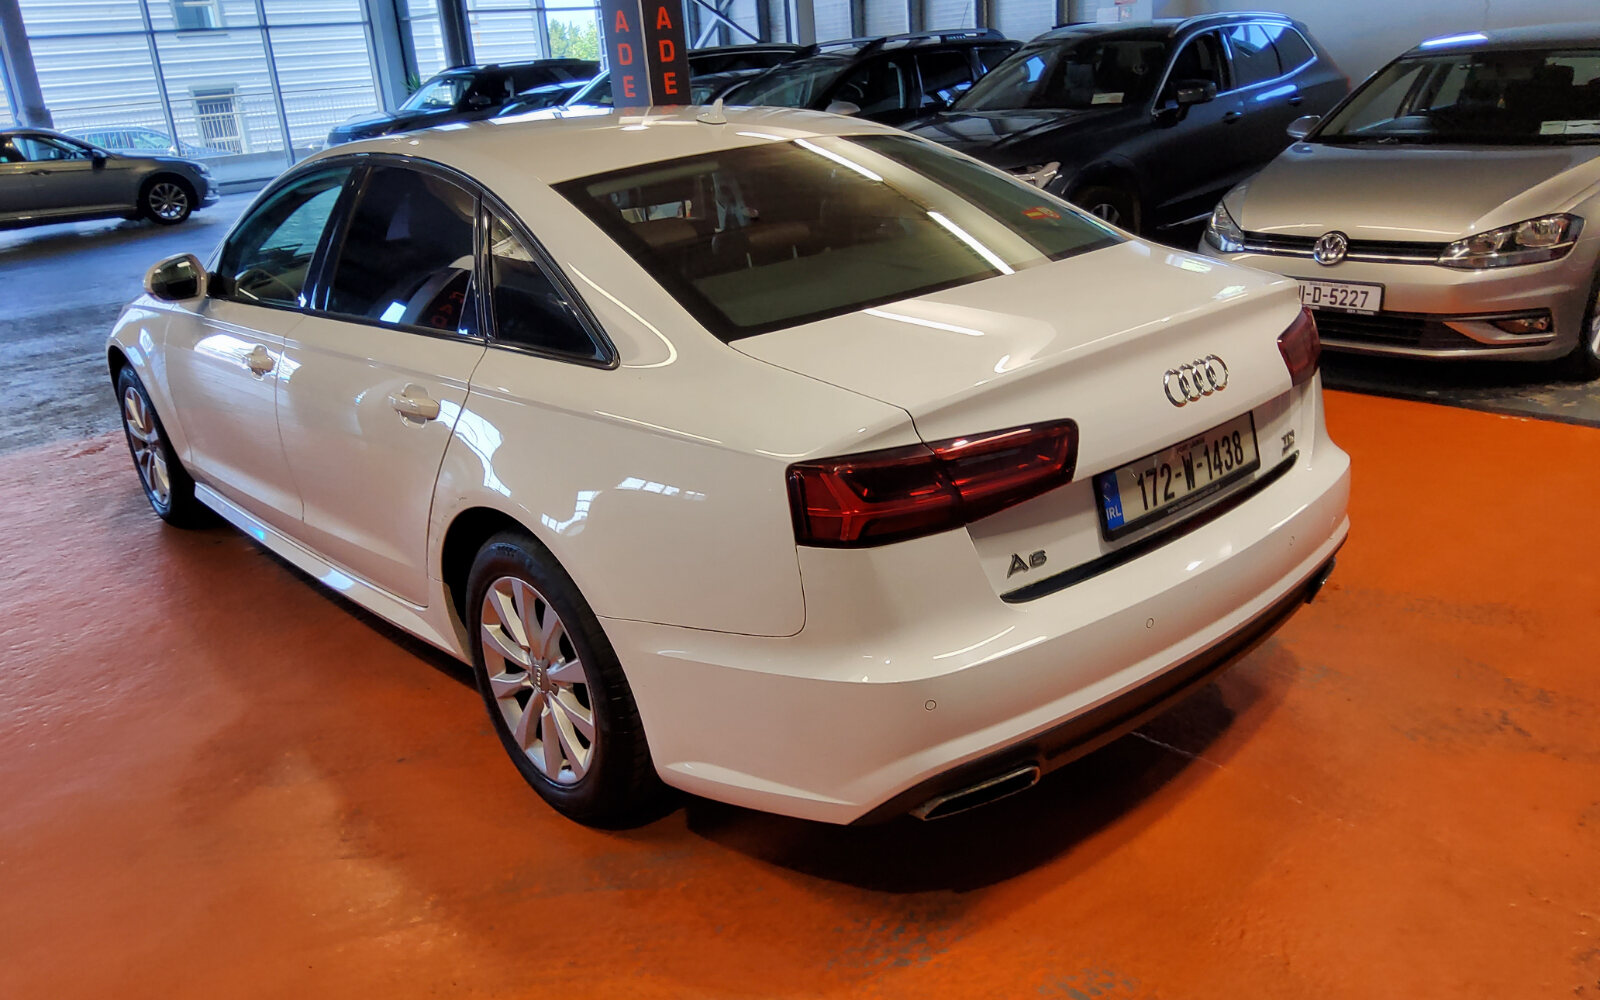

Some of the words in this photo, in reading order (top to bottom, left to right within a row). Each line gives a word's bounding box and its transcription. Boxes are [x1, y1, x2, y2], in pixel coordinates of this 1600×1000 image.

[1137, 430, 1244, 511] 172-W-1438
[1106, 506, 1122, 521] IRL
[1007, 550, 1047, 579] A6
